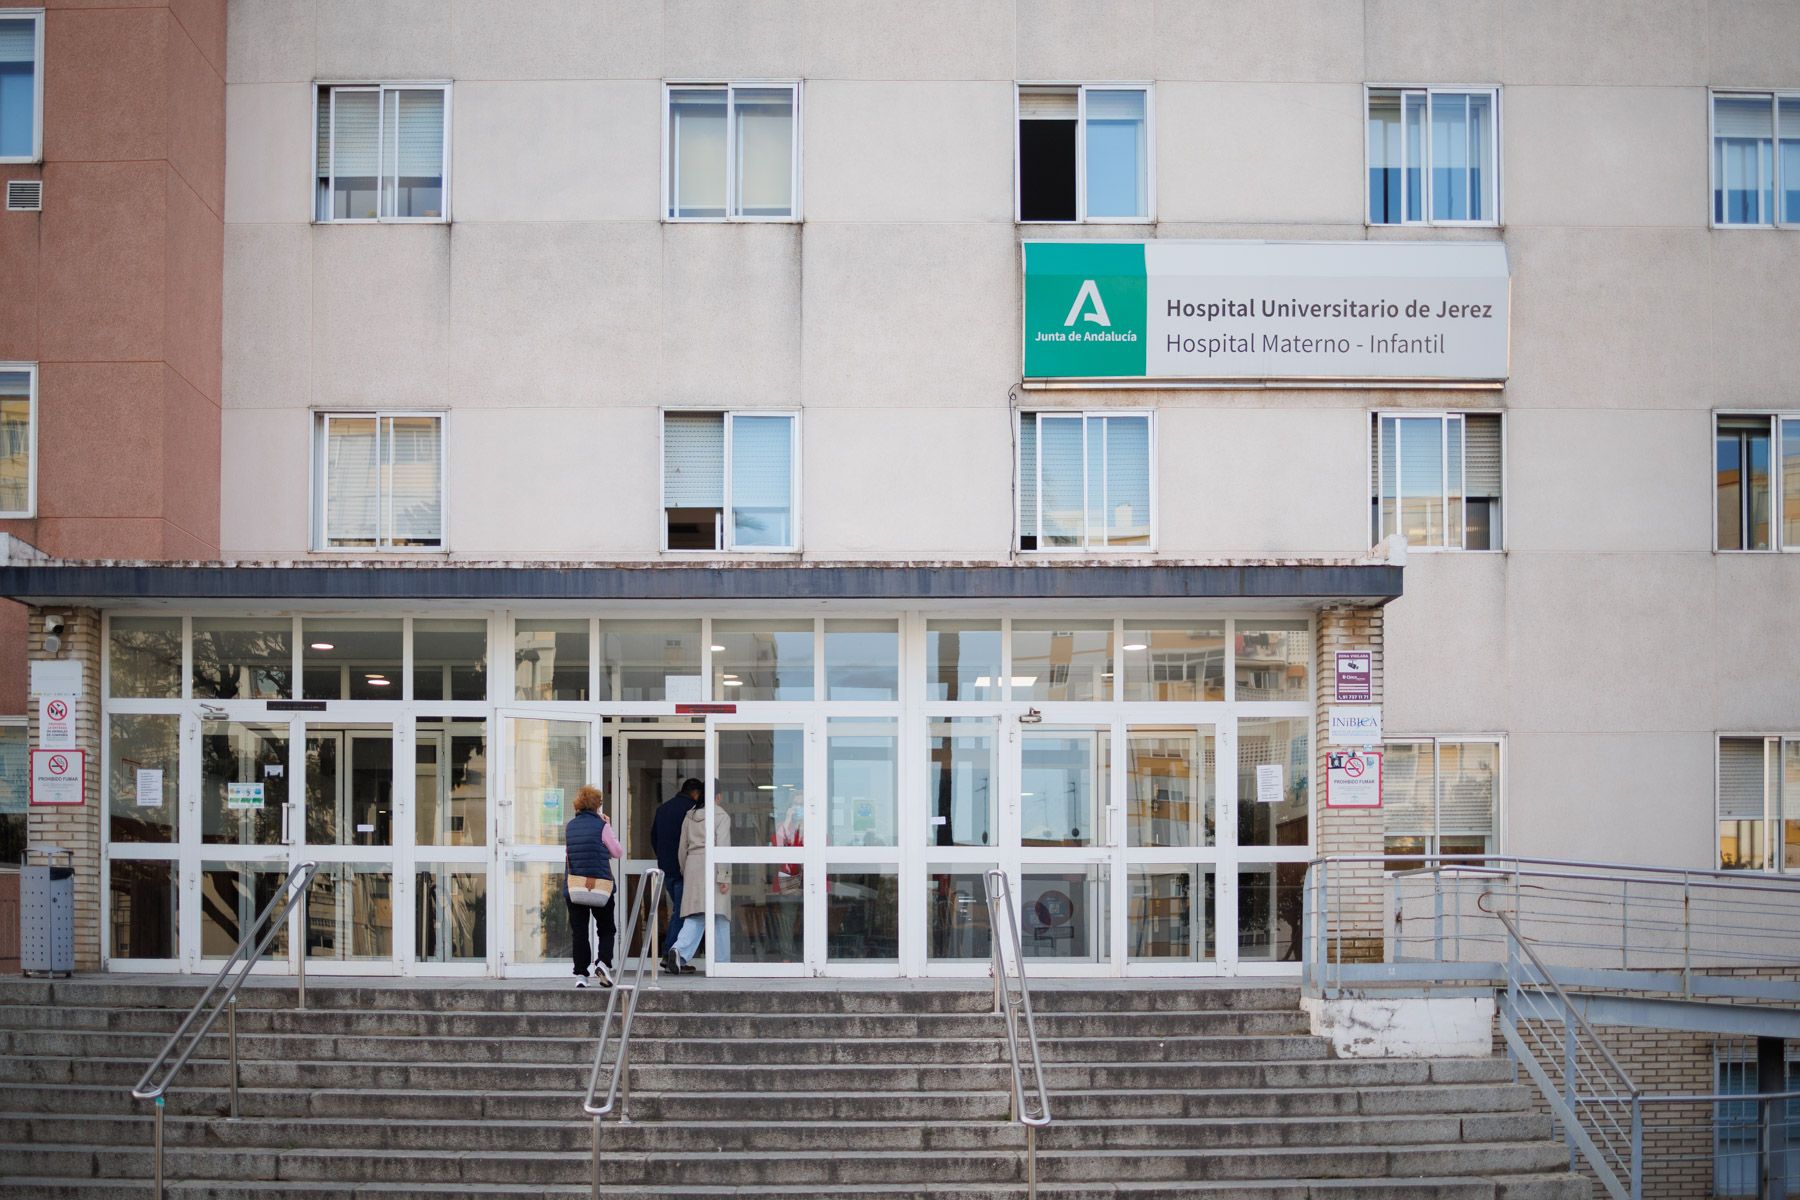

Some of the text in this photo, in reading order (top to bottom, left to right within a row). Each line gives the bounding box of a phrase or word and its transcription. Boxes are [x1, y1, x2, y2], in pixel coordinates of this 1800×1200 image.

[1167, 298, 1493, 322] Hospital Universitario de Jerez
[1035, 330, 1138, 343] Junta de Andalucía
[1167, 333, 1256, 358] Hospital
[1262, 334, 1350, 354] Materno
[1370, 333, 1445, 354] Infantil
